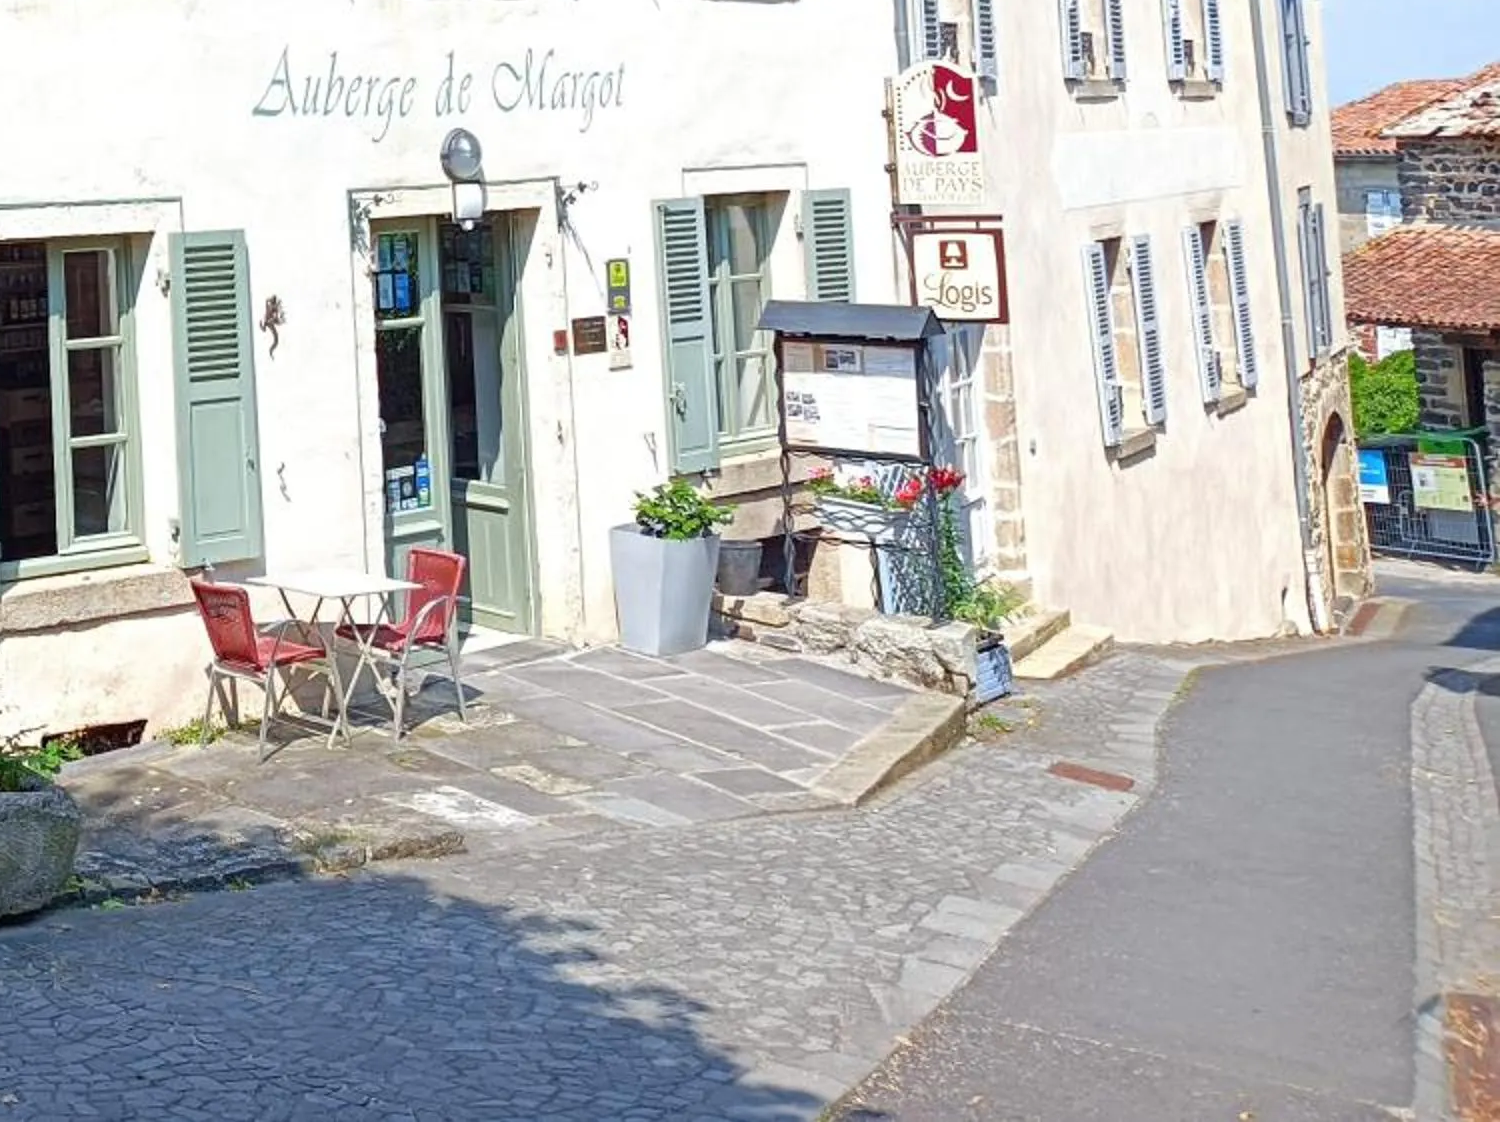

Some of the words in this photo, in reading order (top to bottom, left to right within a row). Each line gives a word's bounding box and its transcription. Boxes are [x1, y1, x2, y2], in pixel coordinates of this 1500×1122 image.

[252, 43, 417, 143] Auberge
[435, 49, 473, 117] de
[492, 47, 625, 133] Margot
[903, 160, 980, 177] AUBERGE
[935, 177, 983, 193] PAYS
[924, 271, 993, 312] Logis
